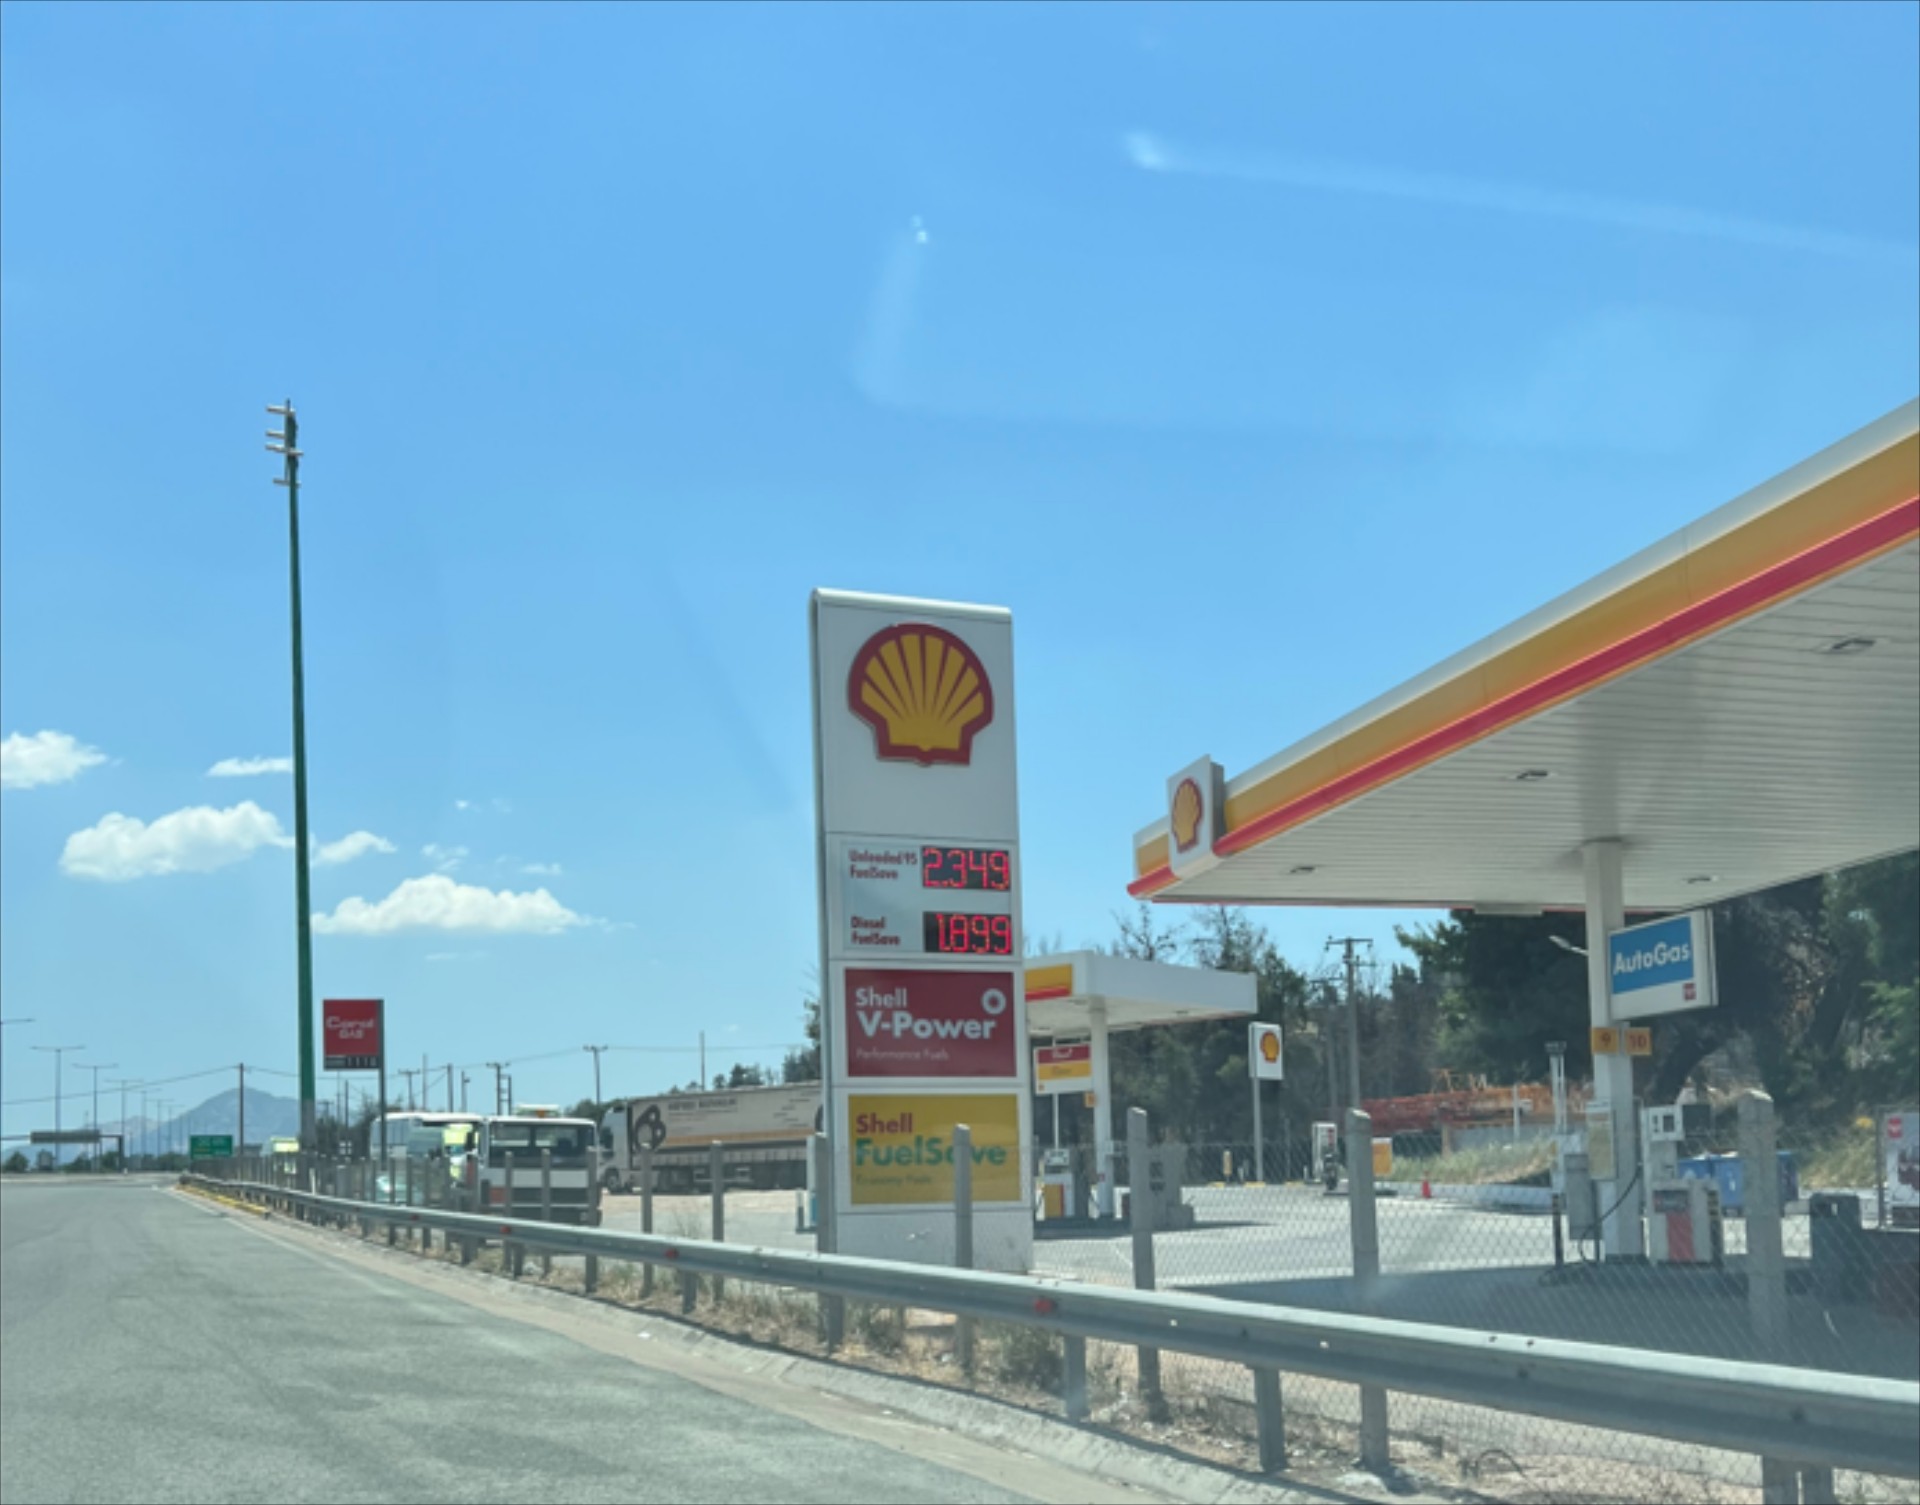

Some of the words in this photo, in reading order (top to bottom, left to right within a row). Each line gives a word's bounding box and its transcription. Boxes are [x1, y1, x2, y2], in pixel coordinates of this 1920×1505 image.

[923, 848, 1010, 889] 2.349
[851, 915, 885, 929] Diesel
[936, 913, 1011, 954] 1.899
[852, 931, 900, 946] FuelSave
[1613, 941, 1690, 975] AutoGas
[855, 987, 908, 1008] Shell
[856, 1010, 996, 1039] V-Power
[855, 1112, 913, 1134] Shell
